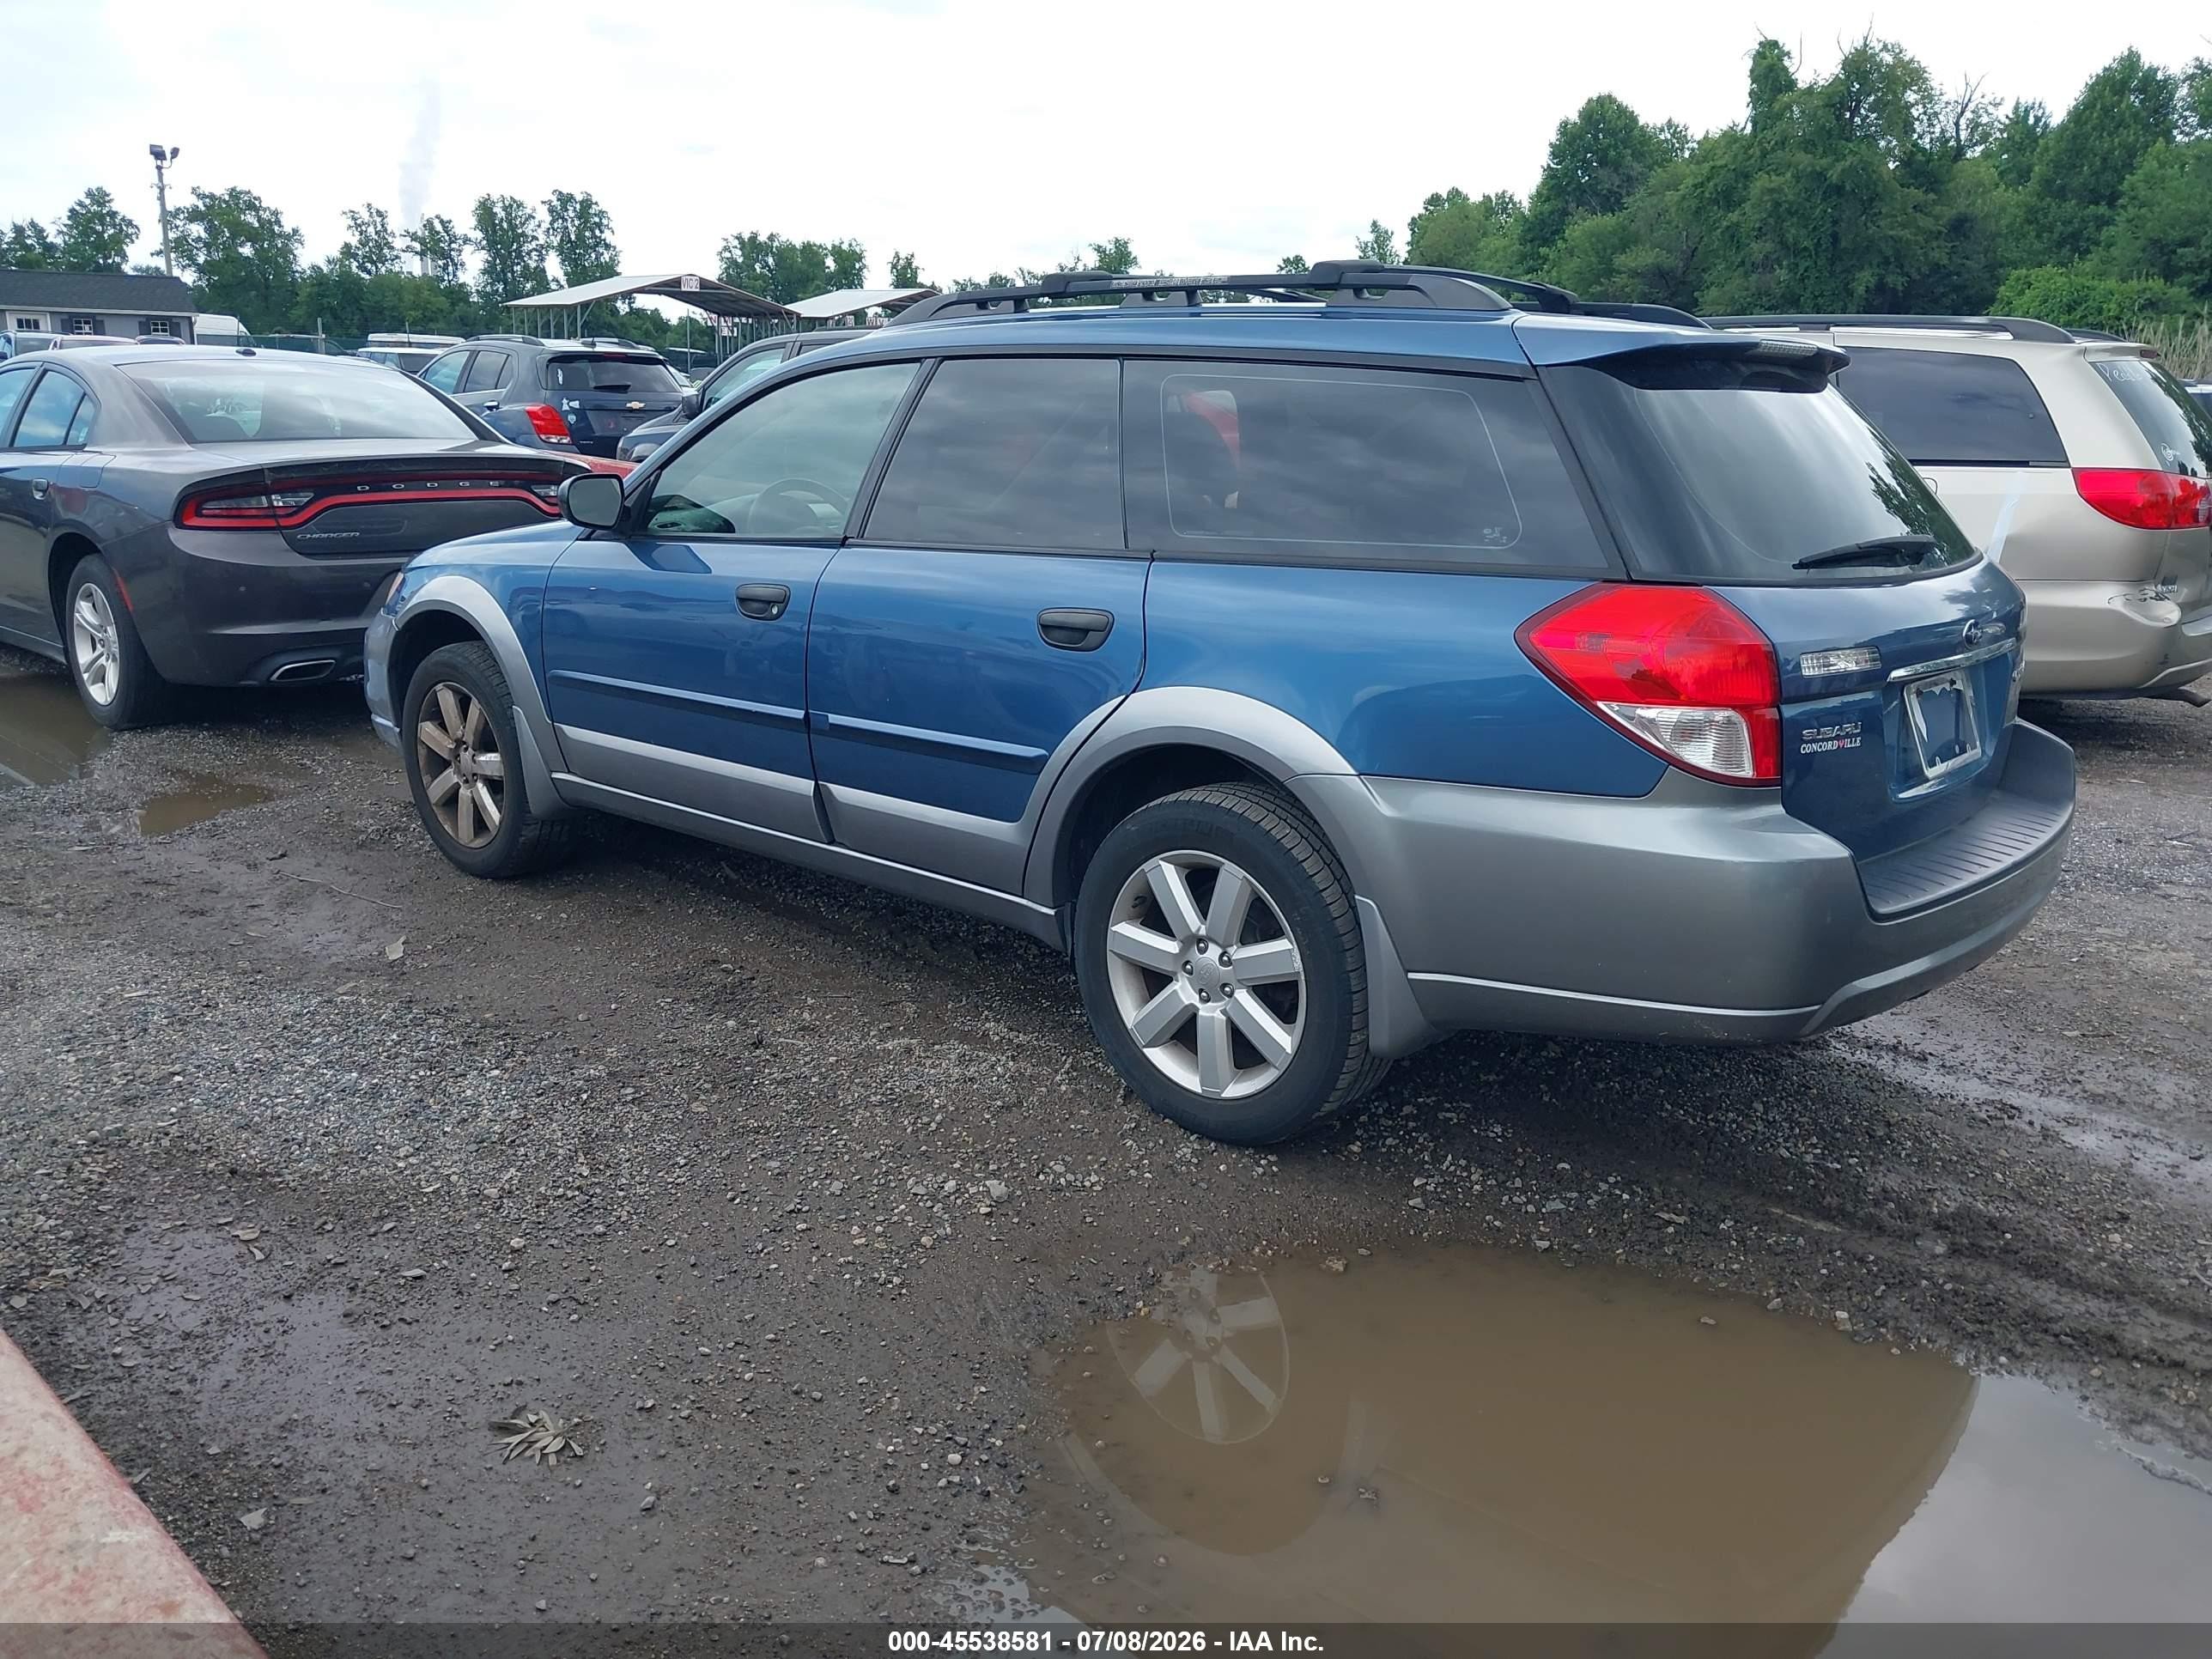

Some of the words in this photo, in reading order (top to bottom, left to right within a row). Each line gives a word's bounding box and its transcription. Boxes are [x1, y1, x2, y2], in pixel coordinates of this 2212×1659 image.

[356, 480, 500, 491] DODGE
[296, 532, 360, 540] CHARGER
[1802, 721, 1863, 739] SUBARU
[1800, 737, 1862, 754] CONCORDVILLE
